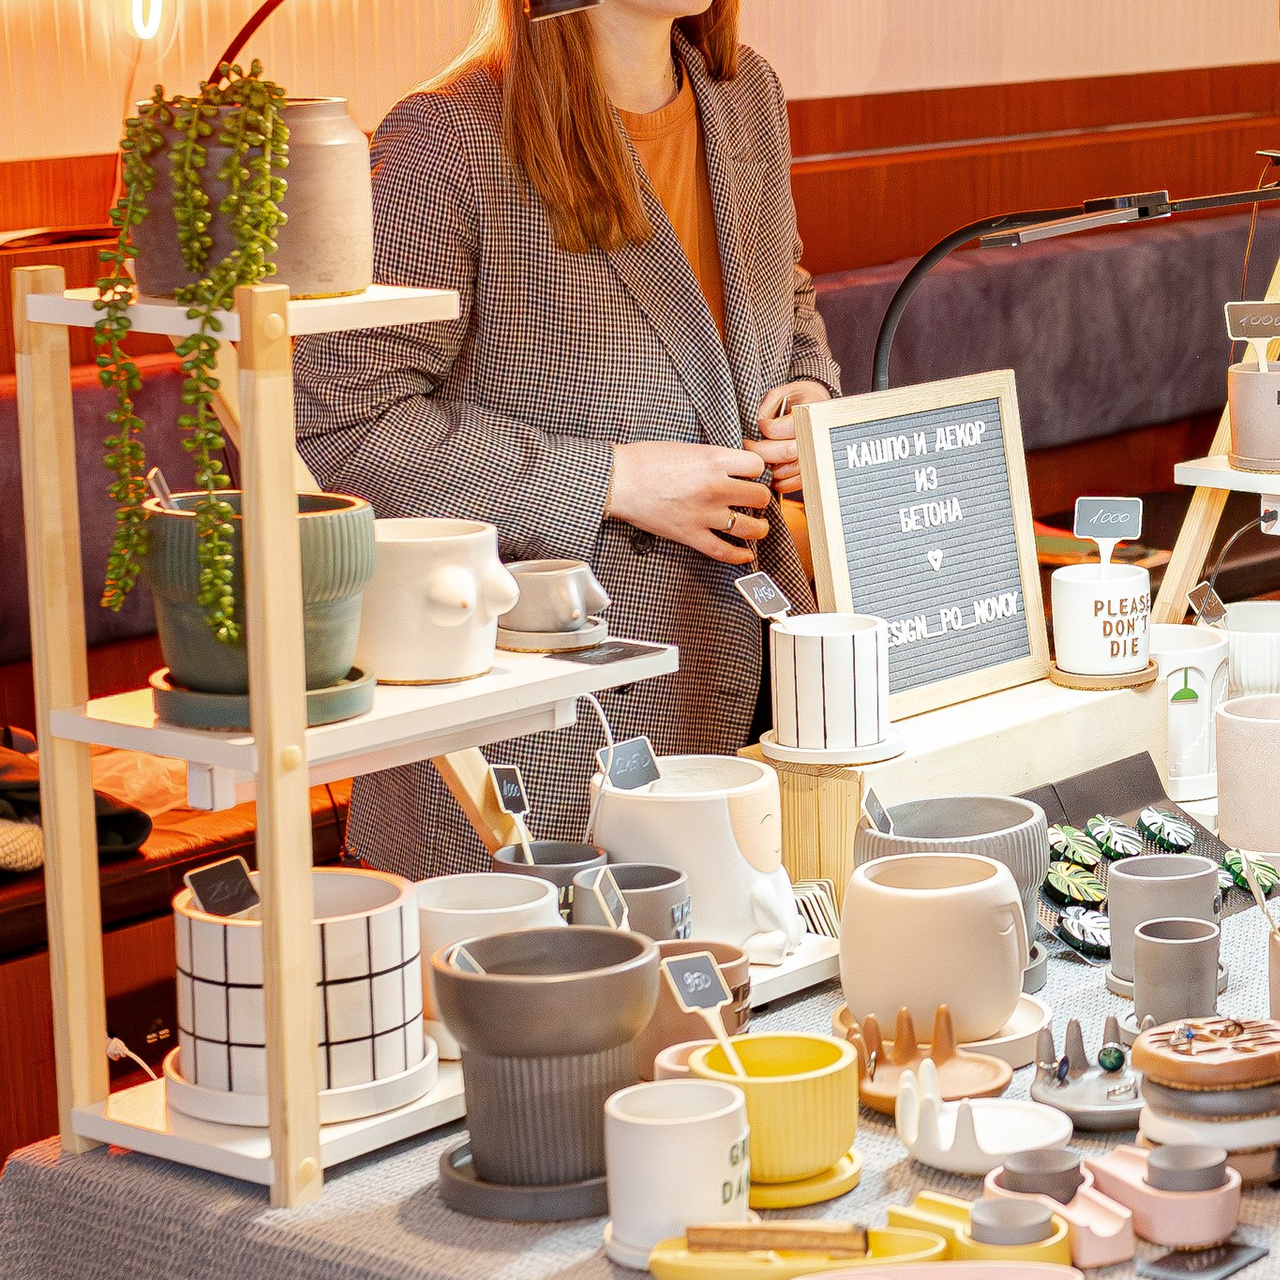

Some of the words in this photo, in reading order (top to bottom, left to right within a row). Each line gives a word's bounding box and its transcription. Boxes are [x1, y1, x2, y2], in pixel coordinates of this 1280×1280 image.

[846, 435, 910, 469] КАШПО
[913, 431, 928, 457] И
[934, 420, 986, 453] ДЕКОР
[914, 466, 938, 493] ИЗ
[898, 497, 964, 533] БЕТОНА
[1089, 509, 1131, 524] 1000
[1094, 593, 1150, 617] PLEASE
[886, 591, 1019, 648] ESIGN_PO_NOVOY
[1103, 614, 1148, 637] DON'T
[1110, 637, 1139, 658] DIE
[683, 971, 712, 993] 950
